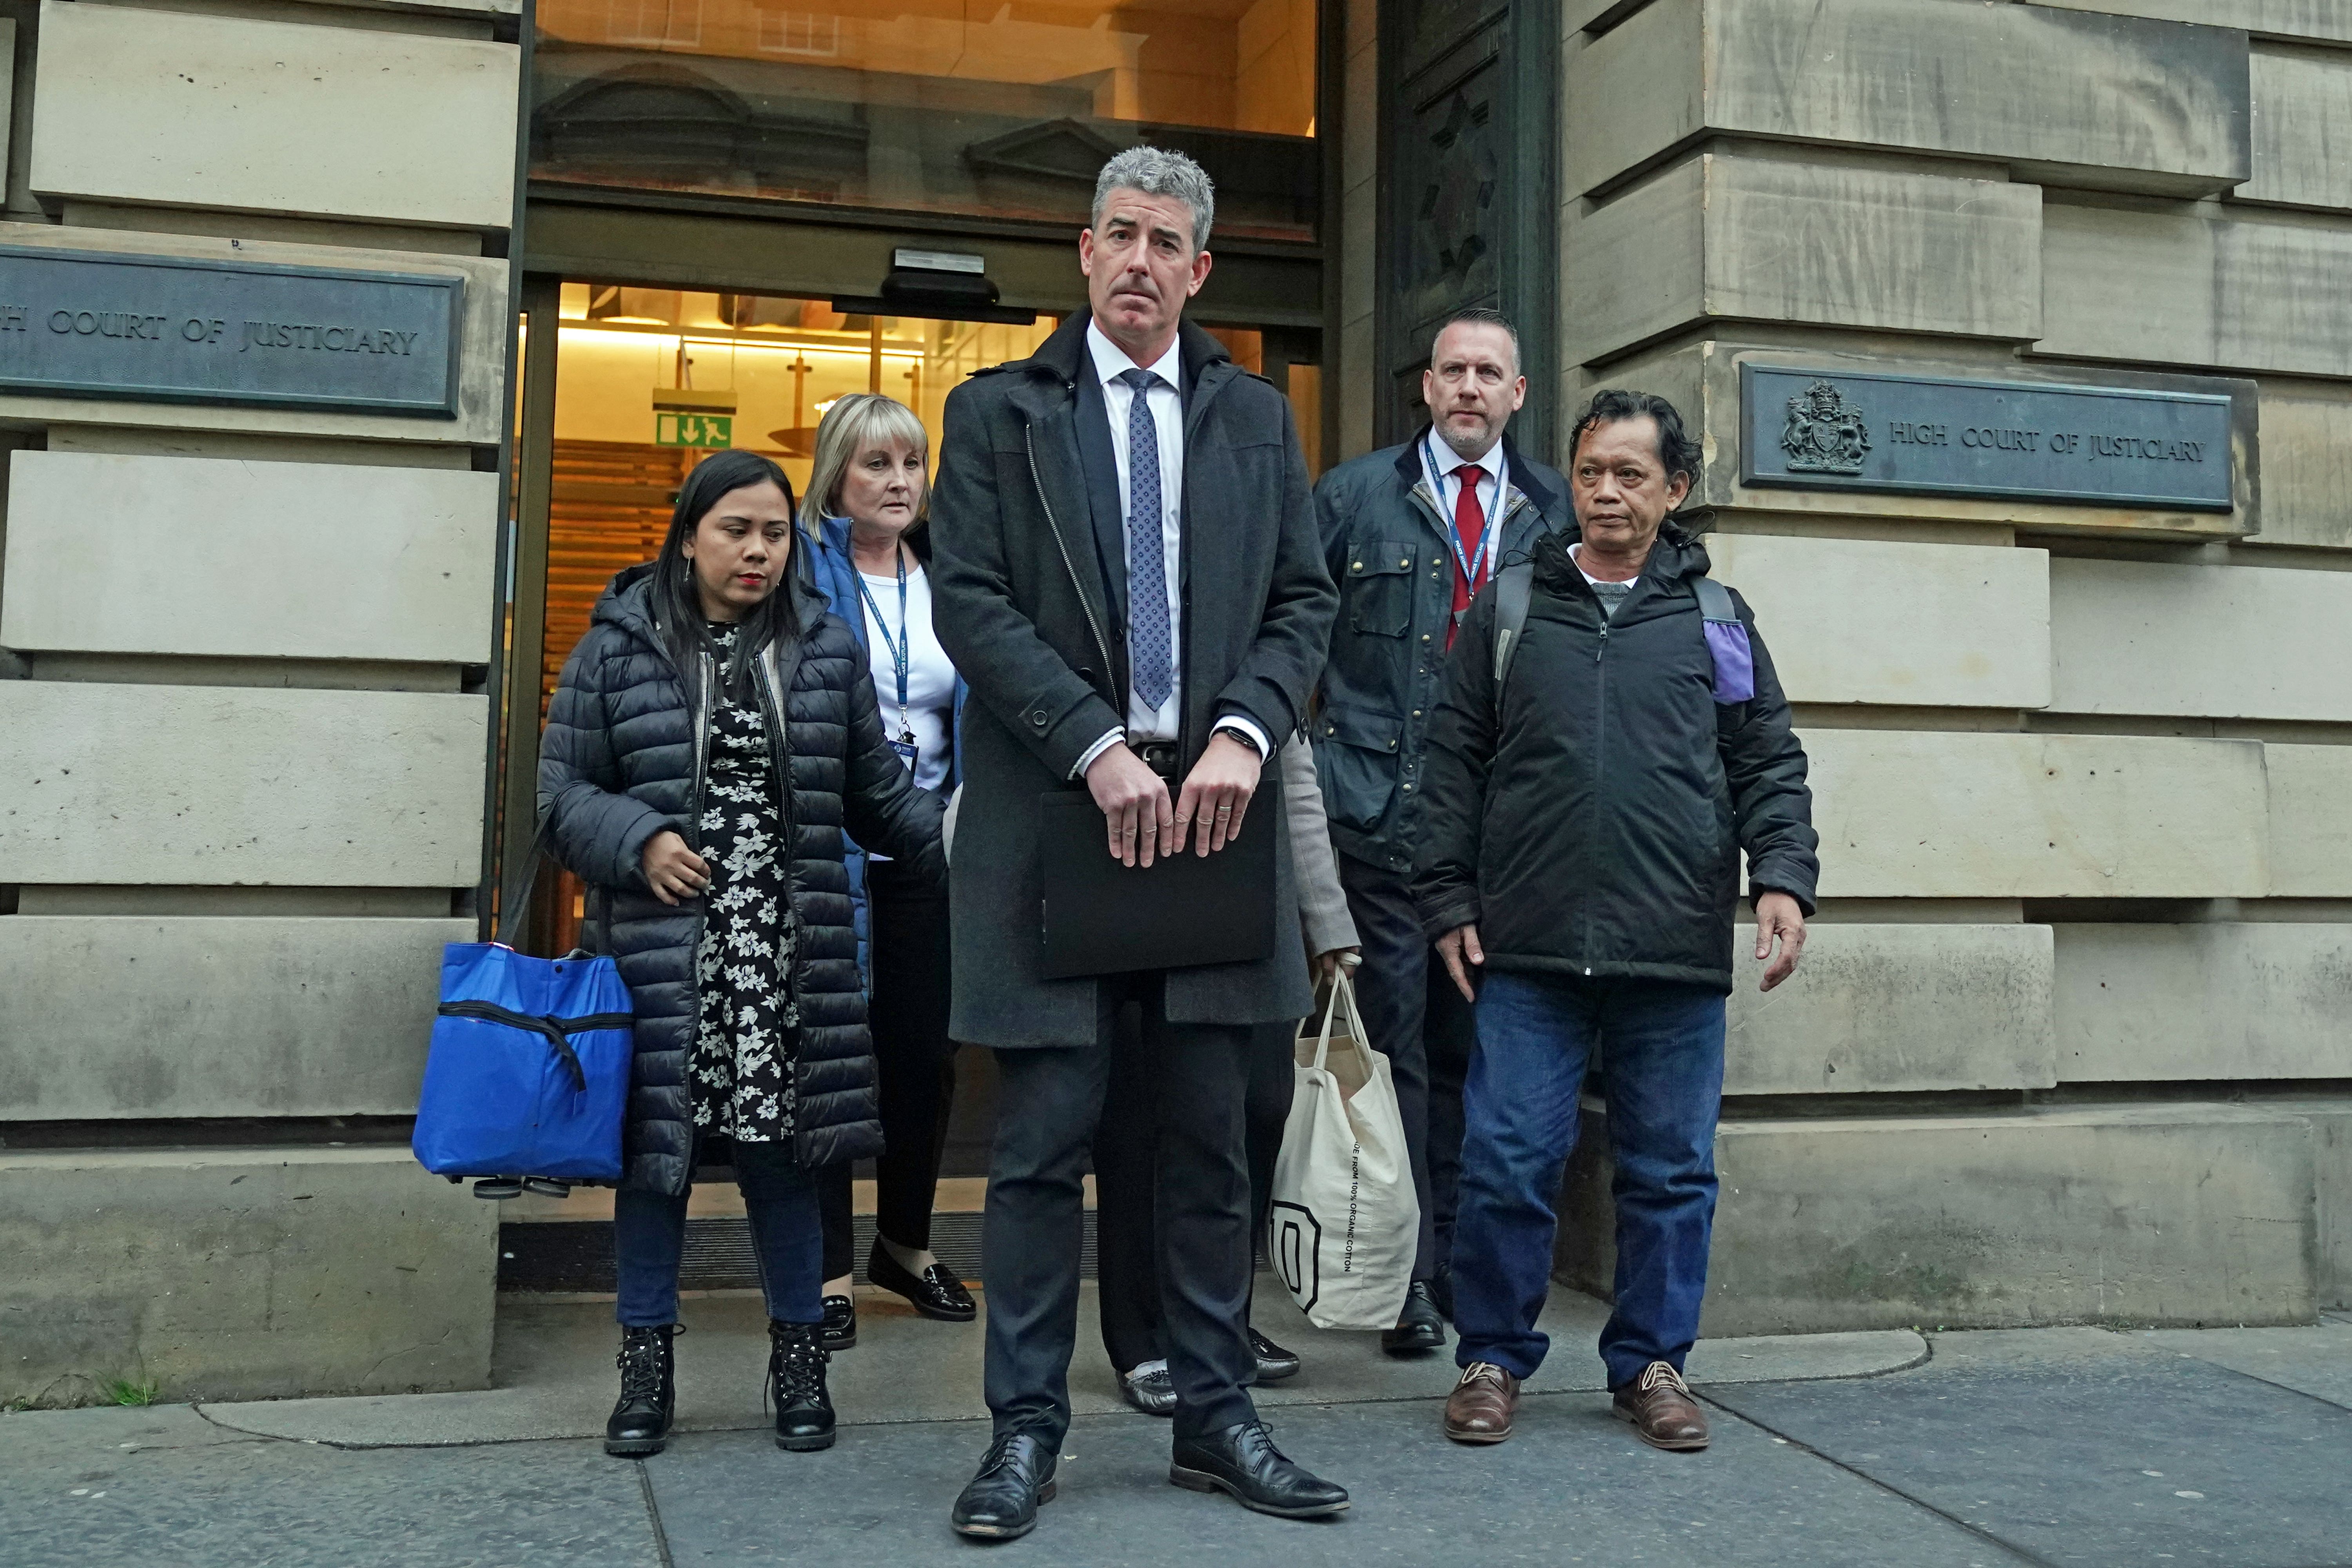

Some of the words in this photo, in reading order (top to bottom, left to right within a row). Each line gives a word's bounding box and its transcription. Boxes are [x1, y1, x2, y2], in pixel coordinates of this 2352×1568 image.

[48, 308, 166, 340] COURT
[181, 317, 225, 343] OF
[240, 320, 417, 355] JUSTICIARY
[1890, 421, 1948, 445] HIGH
[1962, 426, 2042, 452] COURT
[2050, 433, 2078, 454] OF
[2089, 434, 2206, 462] JUSTICIARY
[1431, 463, 1439, 482] SCOTLAND
[1455, 540, 1463, 555] POLICE
[1474, 543, 1484, 563] SCOTLAND
[865, 590, 873, 604] POLICE
[872, 601, 883, 624] SCOTLAND
[887, 638, 895, 652] POLICE
[893, 653, 902, 676] SCOTLAND
[1350, 1181, 1358, 1201] 100%
[1347, 1203, 1357, 1238] ORGANIC
[1344, 1240, 1353, 1272] COTTON
